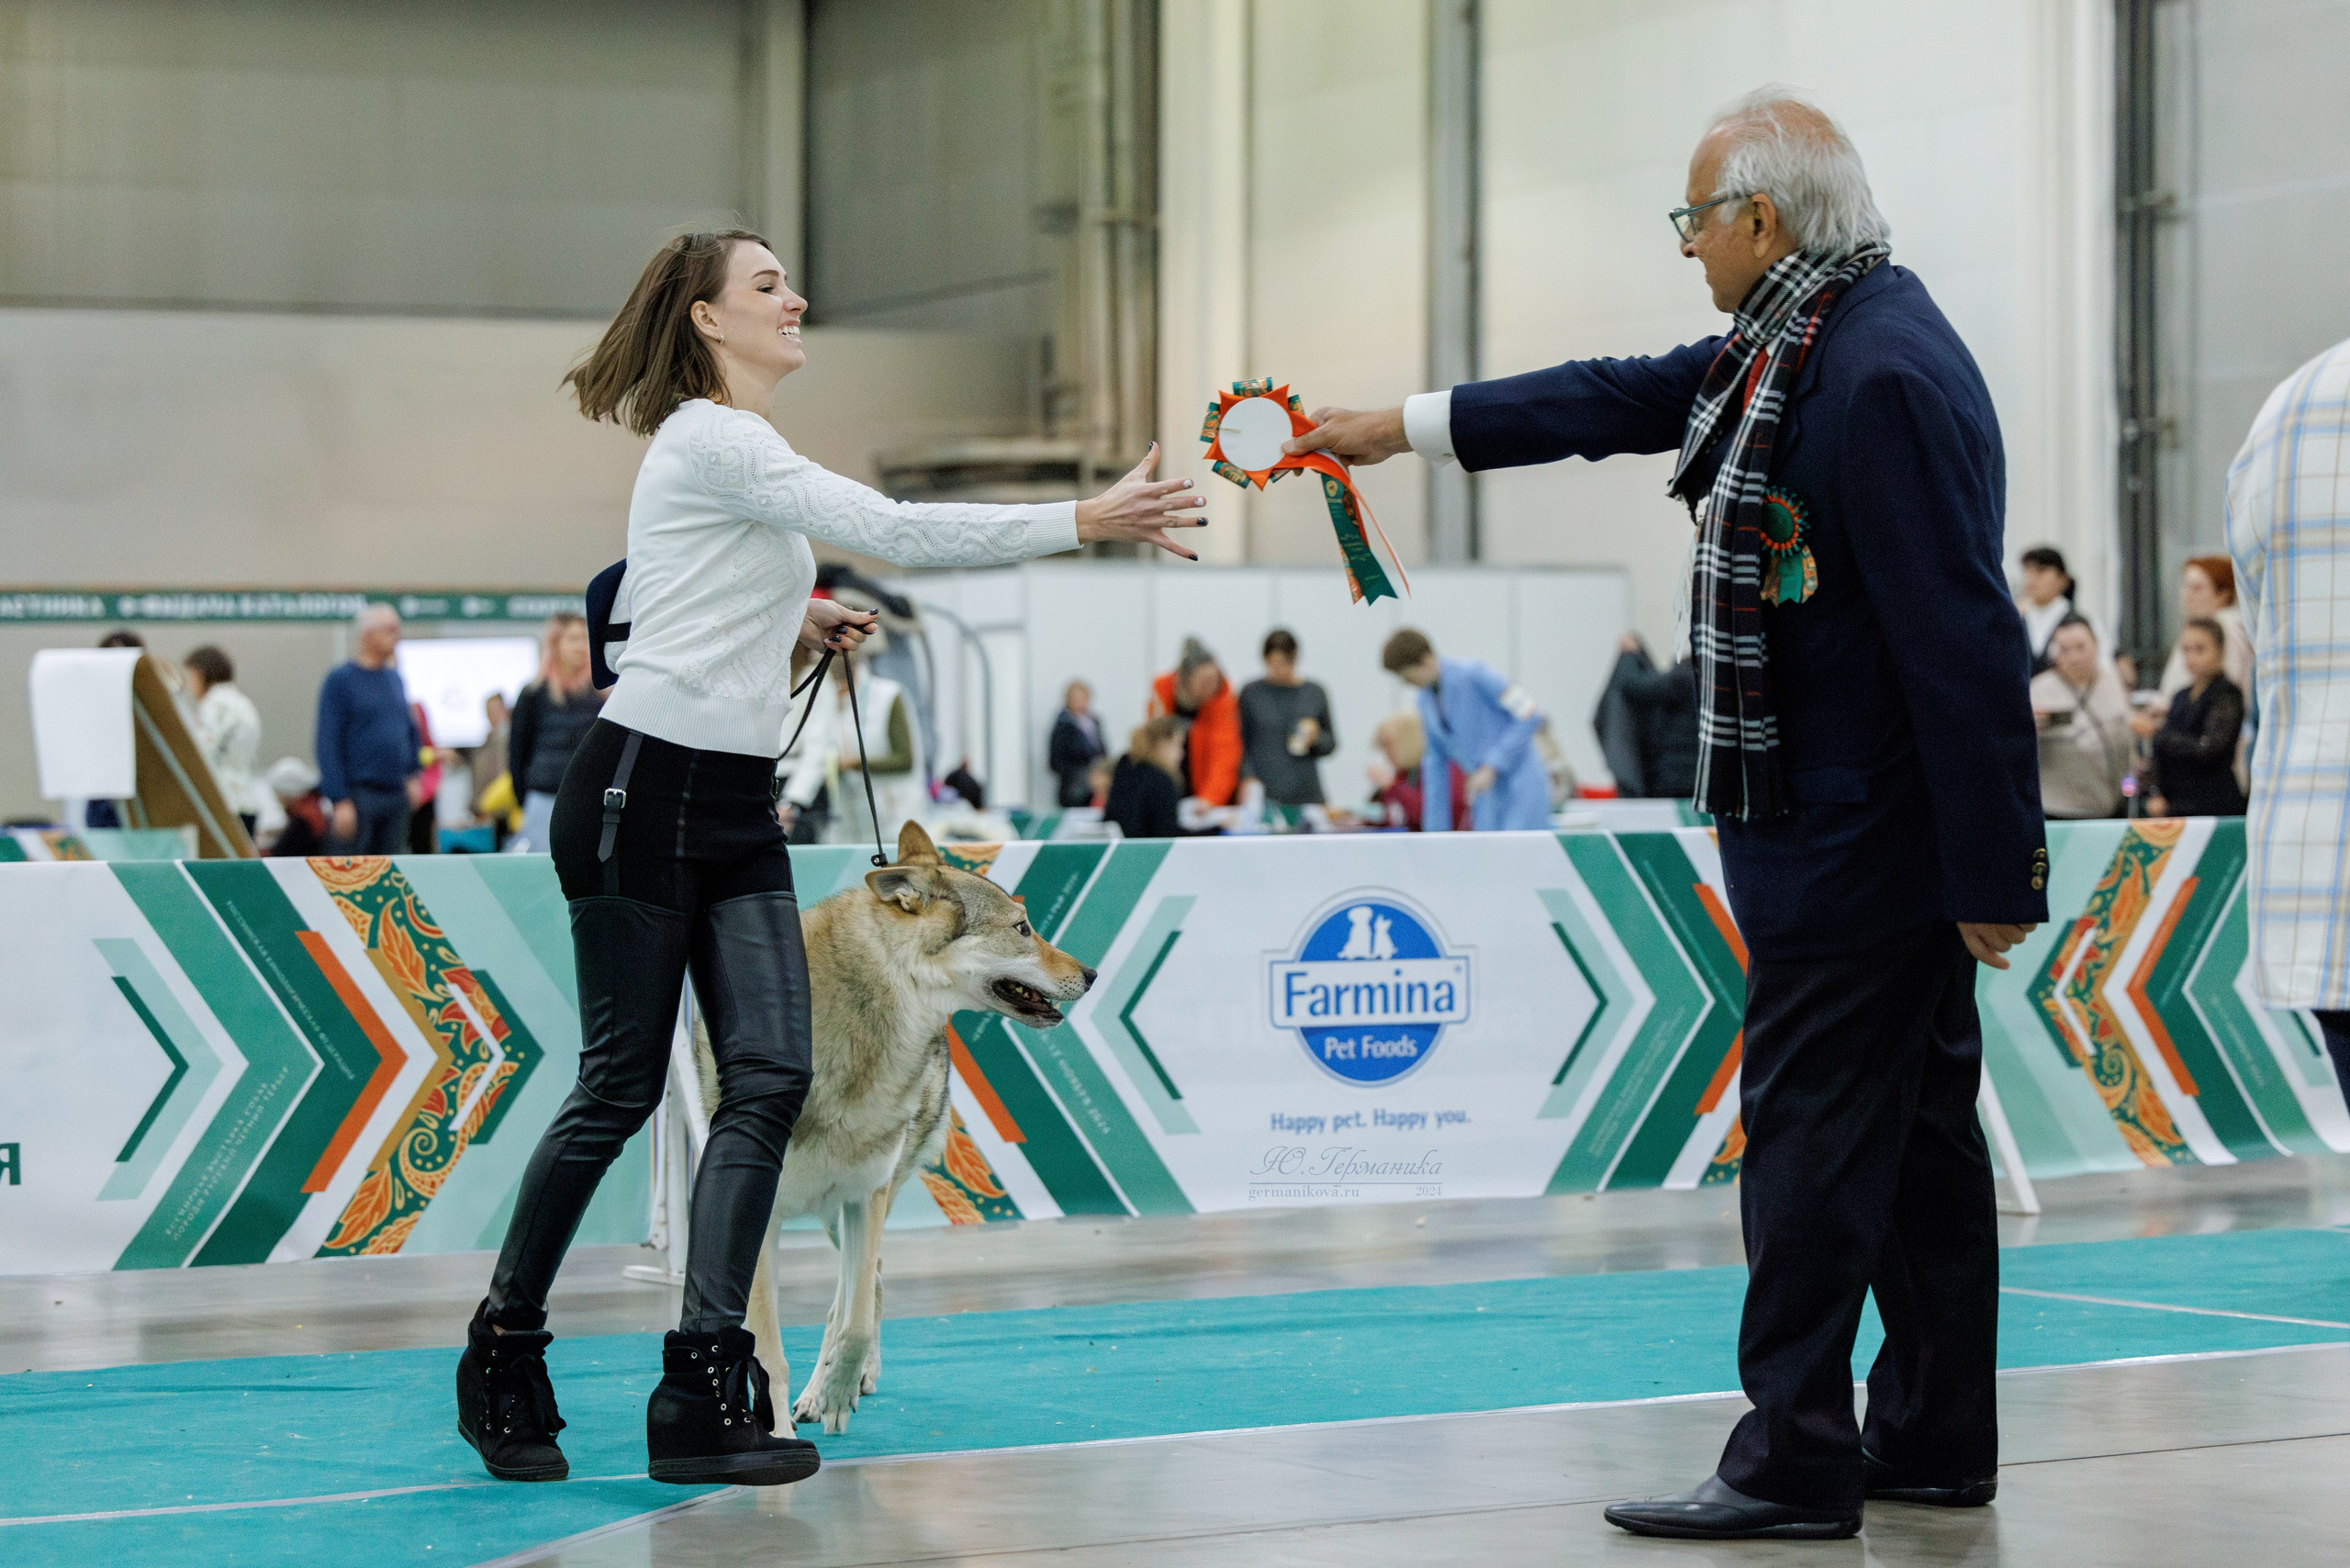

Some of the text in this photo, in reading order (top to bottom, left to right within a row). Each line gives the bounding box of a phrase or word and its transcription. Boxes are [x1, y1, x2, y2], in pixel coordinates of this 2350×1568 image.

[1286, 969, 1454, 1016] Farmina
[1324, 1034, 1418, 1059] Pet Foods
[1270, 1108, 1472, 1135] Happy pet. Happy you.
